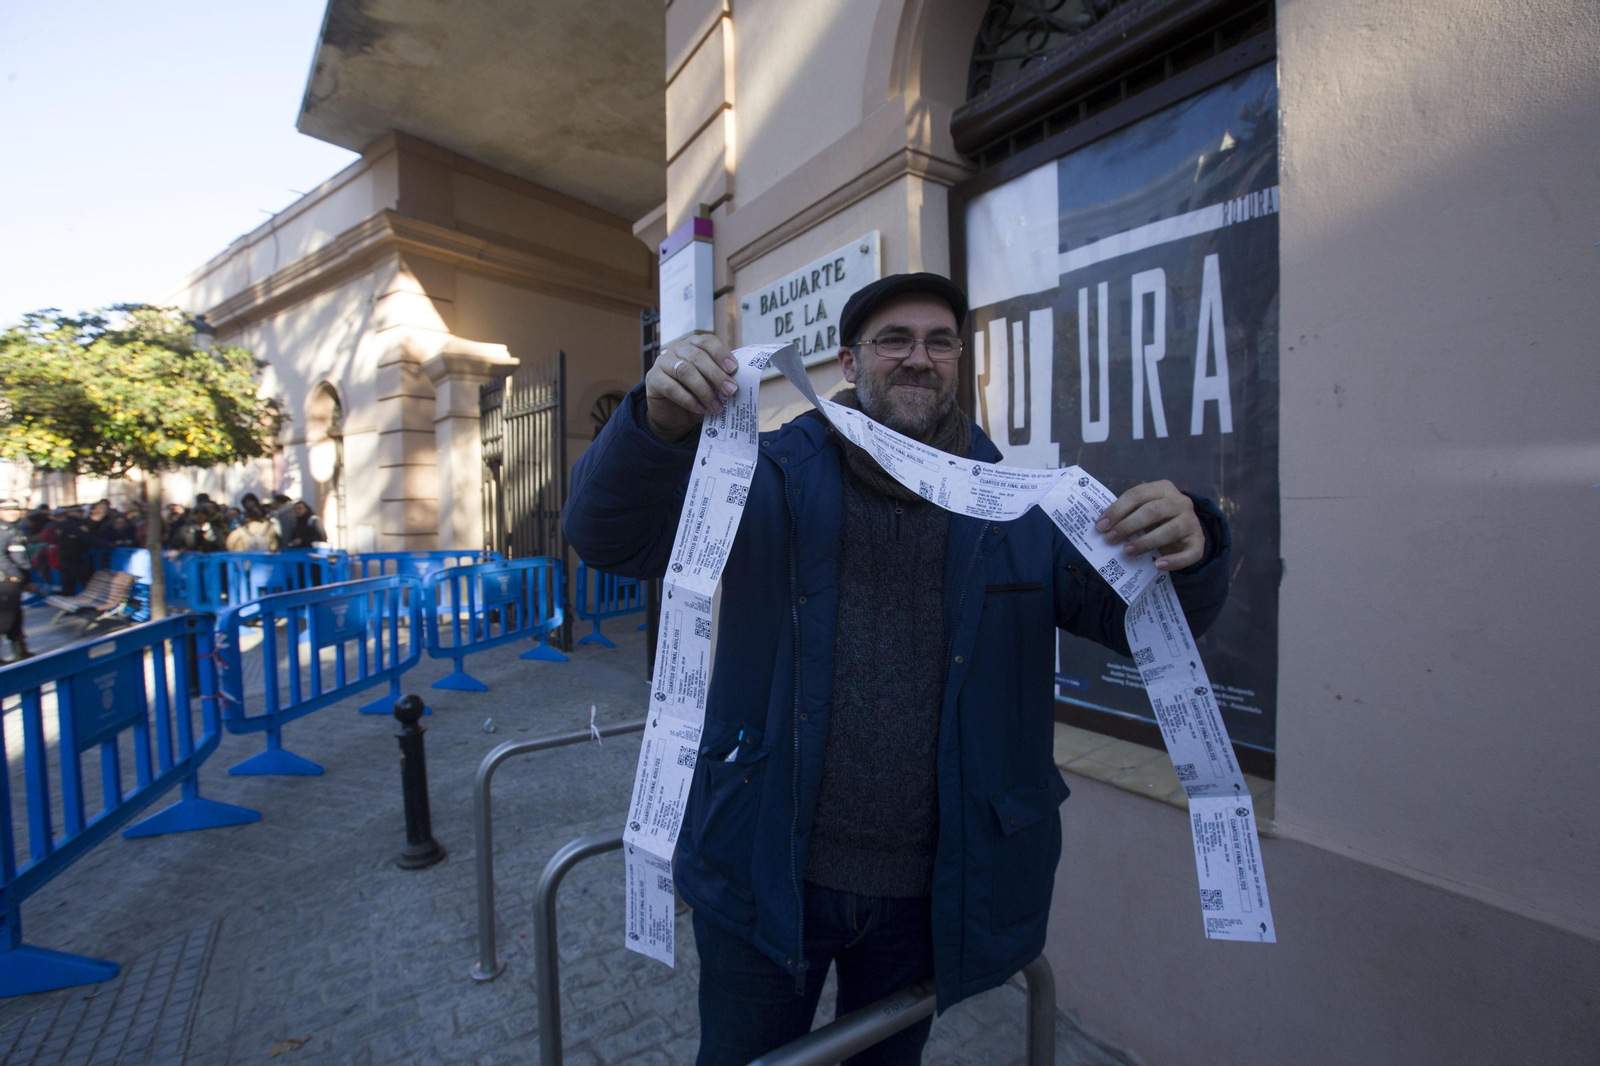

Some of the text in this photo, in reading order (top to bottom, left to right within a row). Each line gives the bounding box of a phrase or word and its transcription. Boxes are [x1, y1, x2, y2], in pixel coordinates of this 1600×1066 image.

[1222, 186, 1276, 227] ROTURA
[760, 257, 846, 316] BALUARTE
[774, 299, 828, 338] DE LA
[720, 406, 728, 430] CUARTOS
[698, 496, 709, 520] ADULTOS
[1081, 490, 1101, 511] CUARTOS
[694, 519, 703, 535] FINAL
[692, 534, 699, 542] DE
[685, 541, 696, 565] CUARTOS
[1149, 588, 1160, 605] CUARTOS
[1157, 609, 1166, 623] FINAL
[672, 628, 680, 651] ADULTOS
[1161, 621, 1173, 642] ADULTOS
[670, 664, 676, 672] DE
[1189, 698, 1202, 719] CUARTOS
[1199, 726, 1210, 740] FINAL
[1204, 740, 1217, 761] ADULTOS
[652, 757, 661, 780] ADULTOS
[649, 779, 657, 795] FINAL
[648, 794, 654, 802] DE
[643, 801, 652, 825] CUARTOS
[1229, 818, 1239, 842] CUARTOS
[1235, 851, 1243, 866] FINAL
[1237, 866, 1247, 891] ADULTOS
